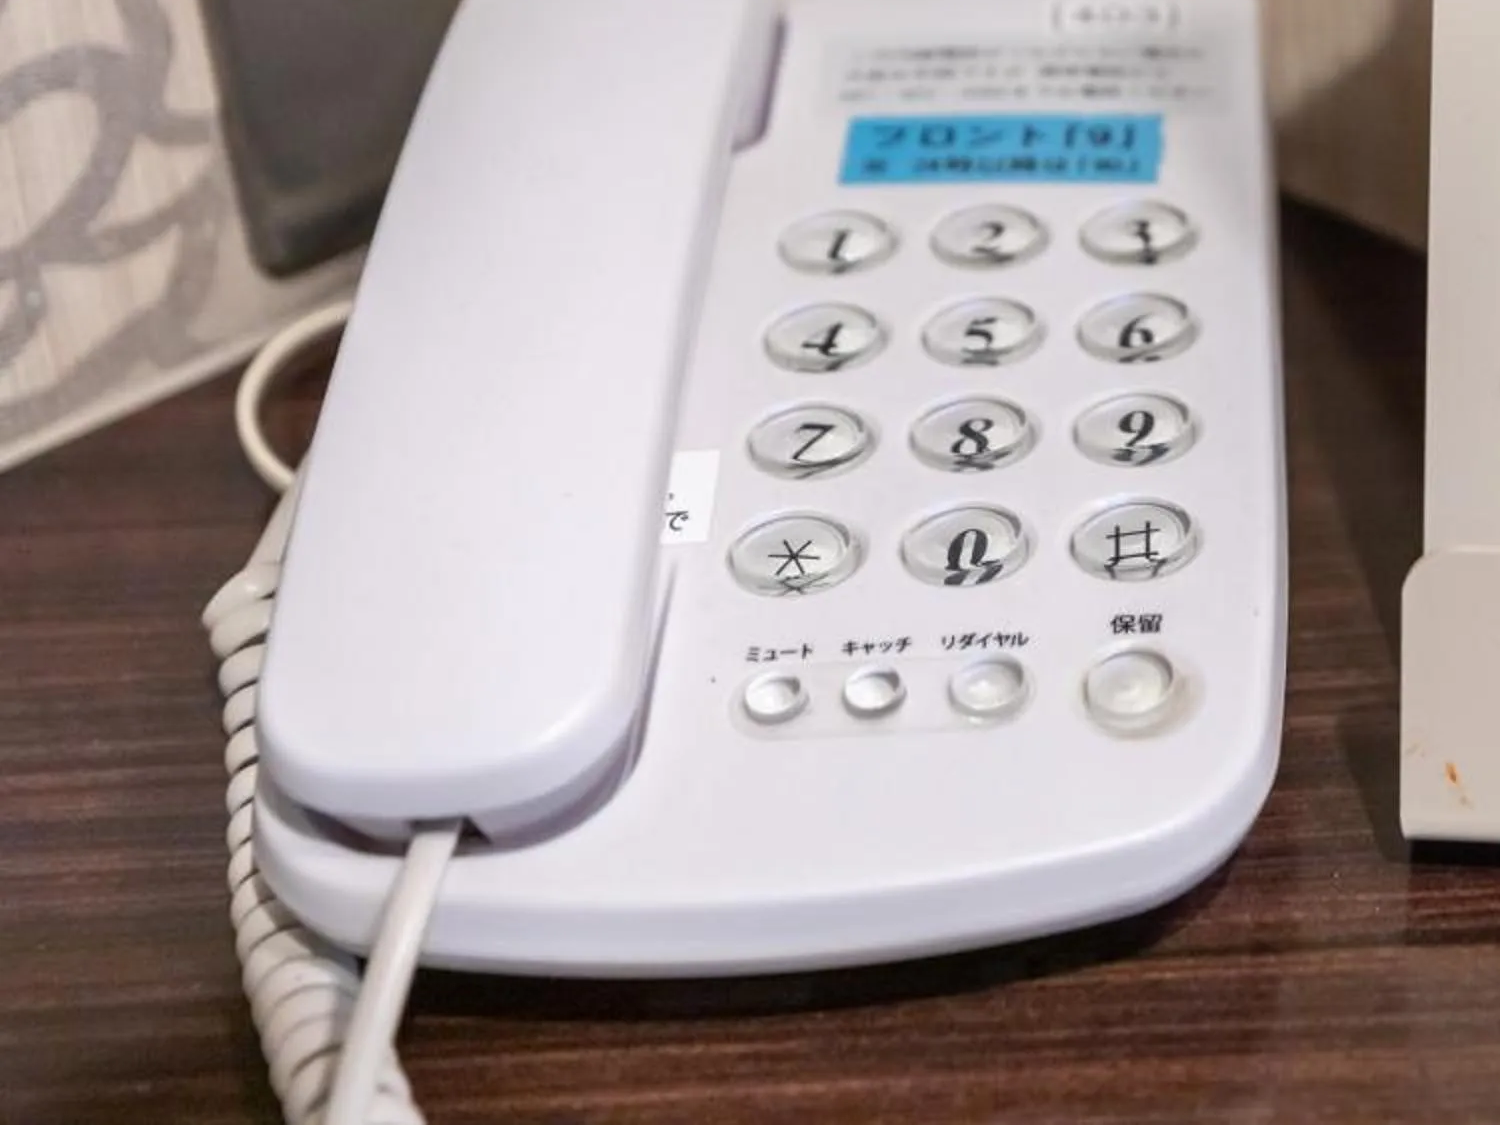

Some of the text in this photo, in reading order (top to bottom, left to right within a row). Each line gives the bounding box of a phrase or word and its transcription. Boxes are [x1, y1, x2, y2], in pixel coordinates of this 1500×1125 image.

[970, 221, 1014, 263] 2
[800, 321, 845, 361] 4
[961, 317, 1000, 355] 5
[1117, 313, 1161, 351] 6
[791, 422, 836, 465] 7
[950, 416, 996, 463] 8
[1115, 409, 1158, 457] 9
[663, 510, 690, 532] で
[946, 526, 992, 575] 0
[940, 628, 1030, 652] リダイヤル
[1109, 612, 1164, 635] 保留
[744, 642, 814, 663] ミュート
[840, 634, 914, 657] キャッチ
